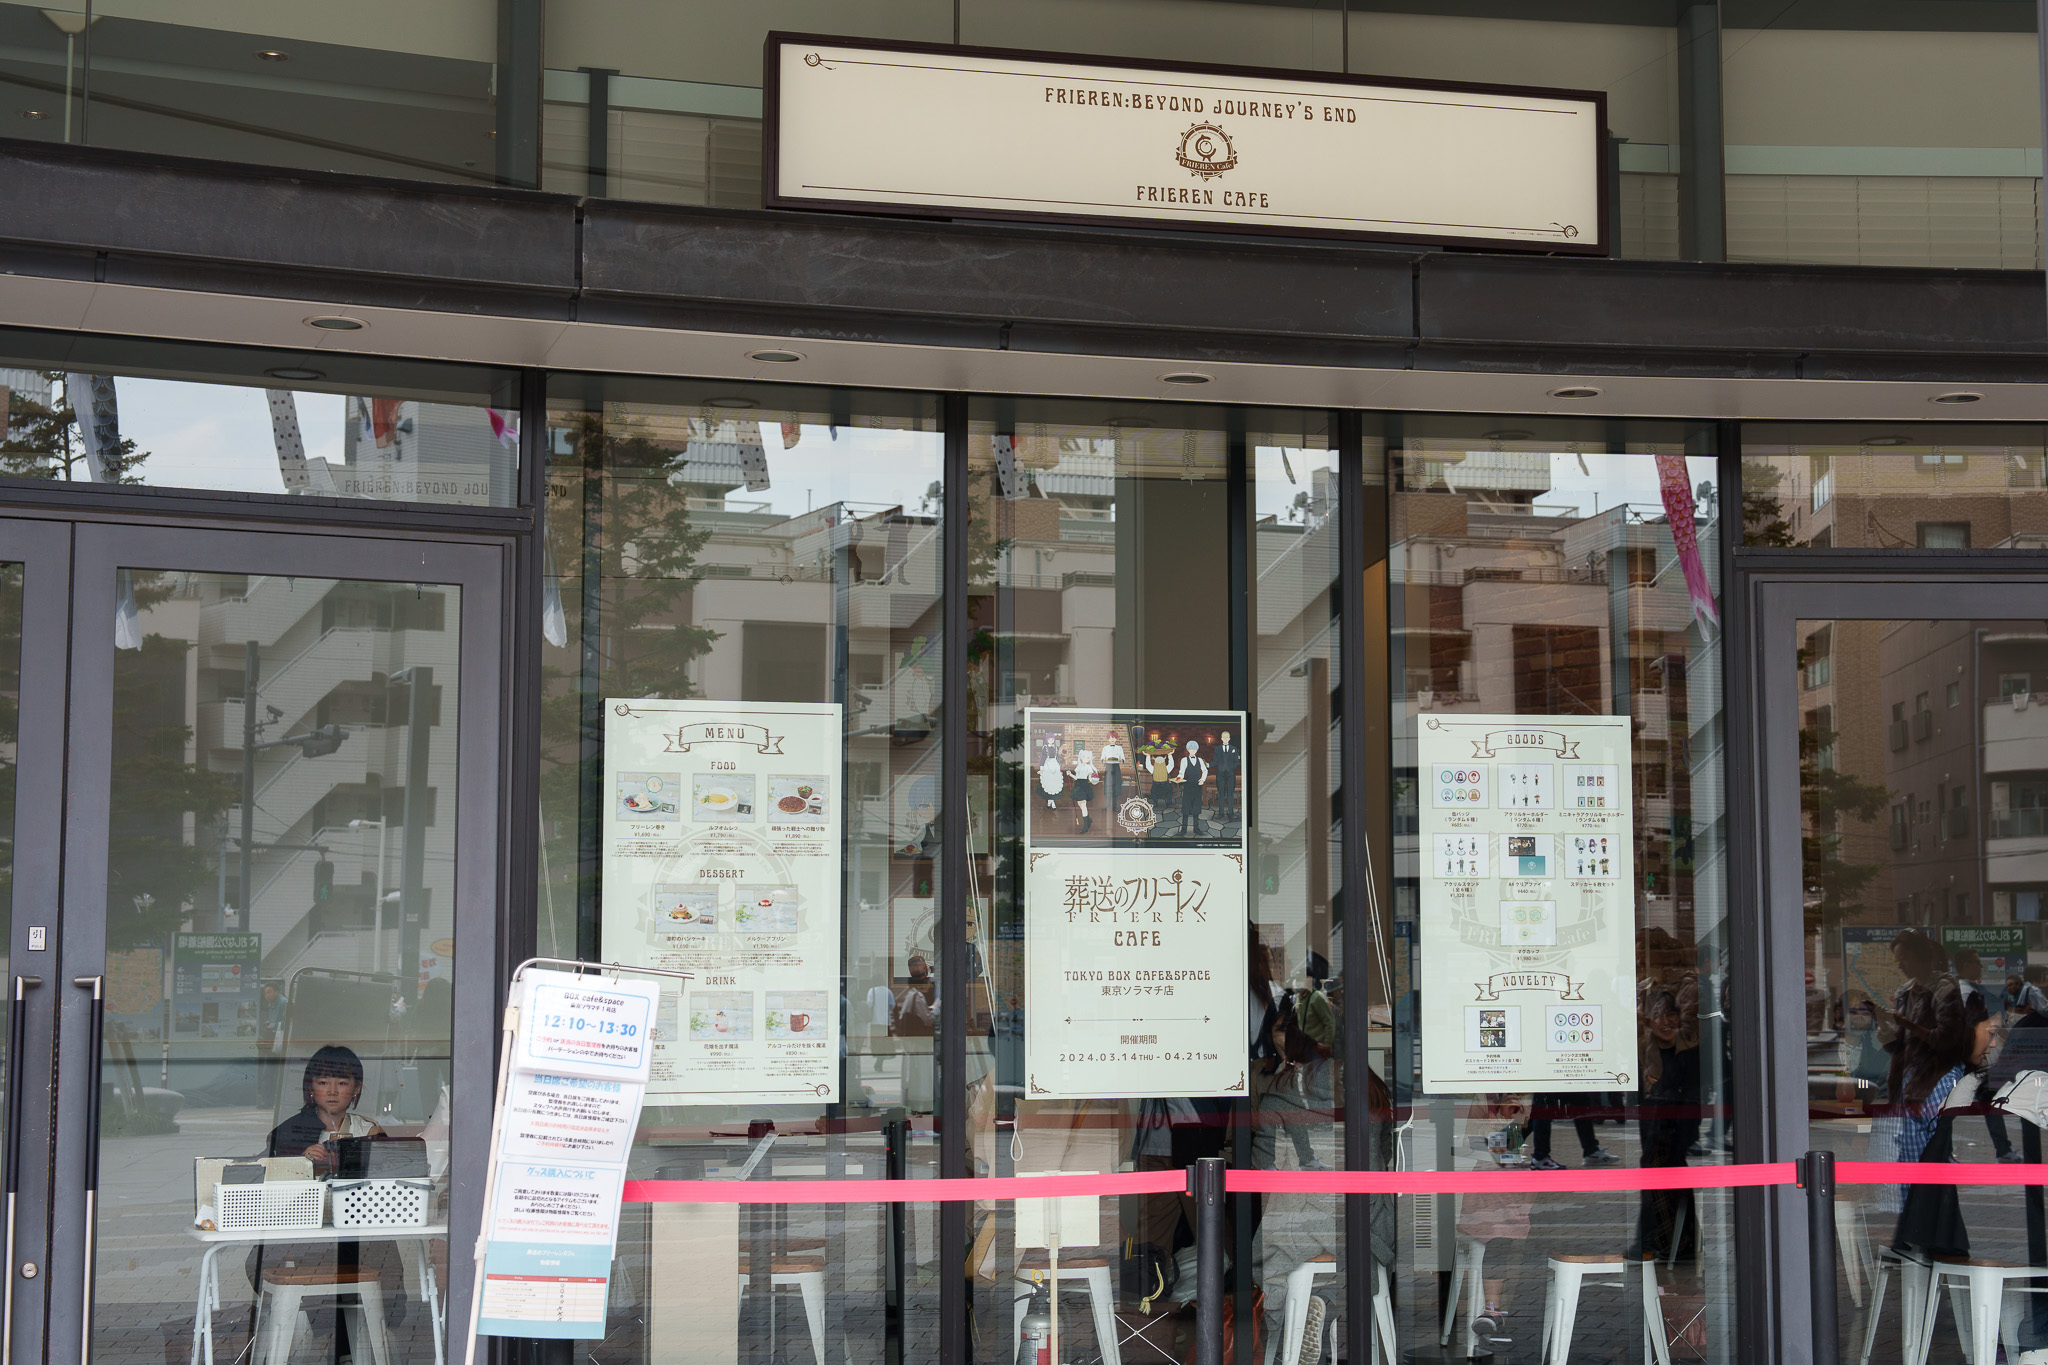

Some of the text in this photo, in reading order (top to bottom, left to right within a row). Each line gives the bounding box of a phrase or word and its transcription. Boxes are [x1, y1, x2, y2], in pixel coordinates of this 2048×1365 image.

[1045, 87, 1357, 124] FRIEREN:BEYOND JOURNEY'S END
[1136, 185, 1270, 208] FRIEREN CAFE
[705, 727, 746, 739] MENU
[1507, 734, 1545, 745] GOODS
[710, 761, 737, 770] FOOD
[699, 869, 745, 879] DESSERT
[1063, 869, 1211, 913] 葬送のフリーレン
[32, 929, 42, 939] 引
[1114, 930, 1161, 947] CAFE
[705, 976, 737, 986] DRINK
[1063, 970, 1211, 982] TOKYO BOX CAFE&SPACE
[1502, 975, 1557, 988] NOVELTY
[1101, 985, 1175, 997] 東京ソラマチ店
[564, 992, 625, 1007] BOX cafe&space
[1120, 1034, 1158, 1045] 開催期間
